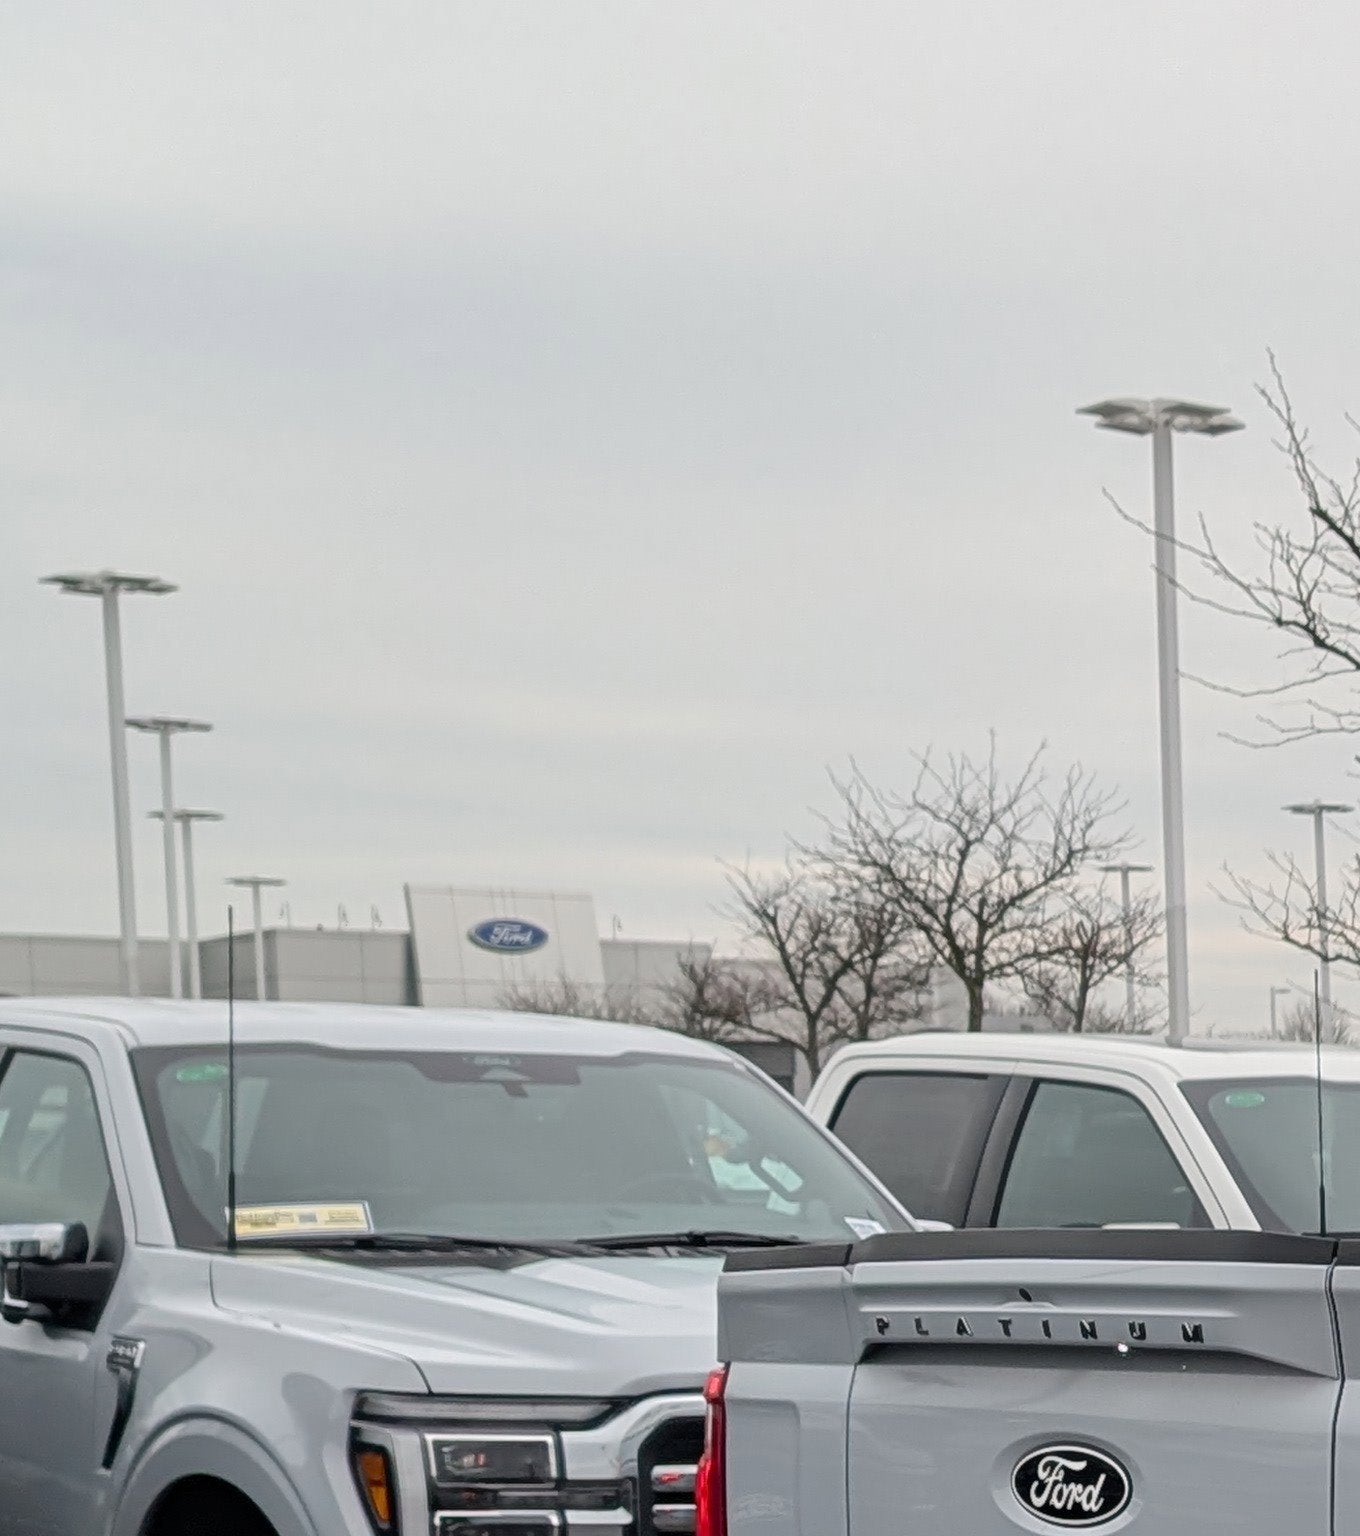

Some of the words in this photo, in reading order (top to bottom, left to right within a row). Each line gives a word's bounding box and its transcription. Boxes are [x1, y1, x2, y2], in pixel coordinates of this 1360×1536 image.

[489, 923, 534, 946] Ford
[875, 1316, 1204, 1343] PLATINUM
[1029, 1455, 1107, 1512] Ford
